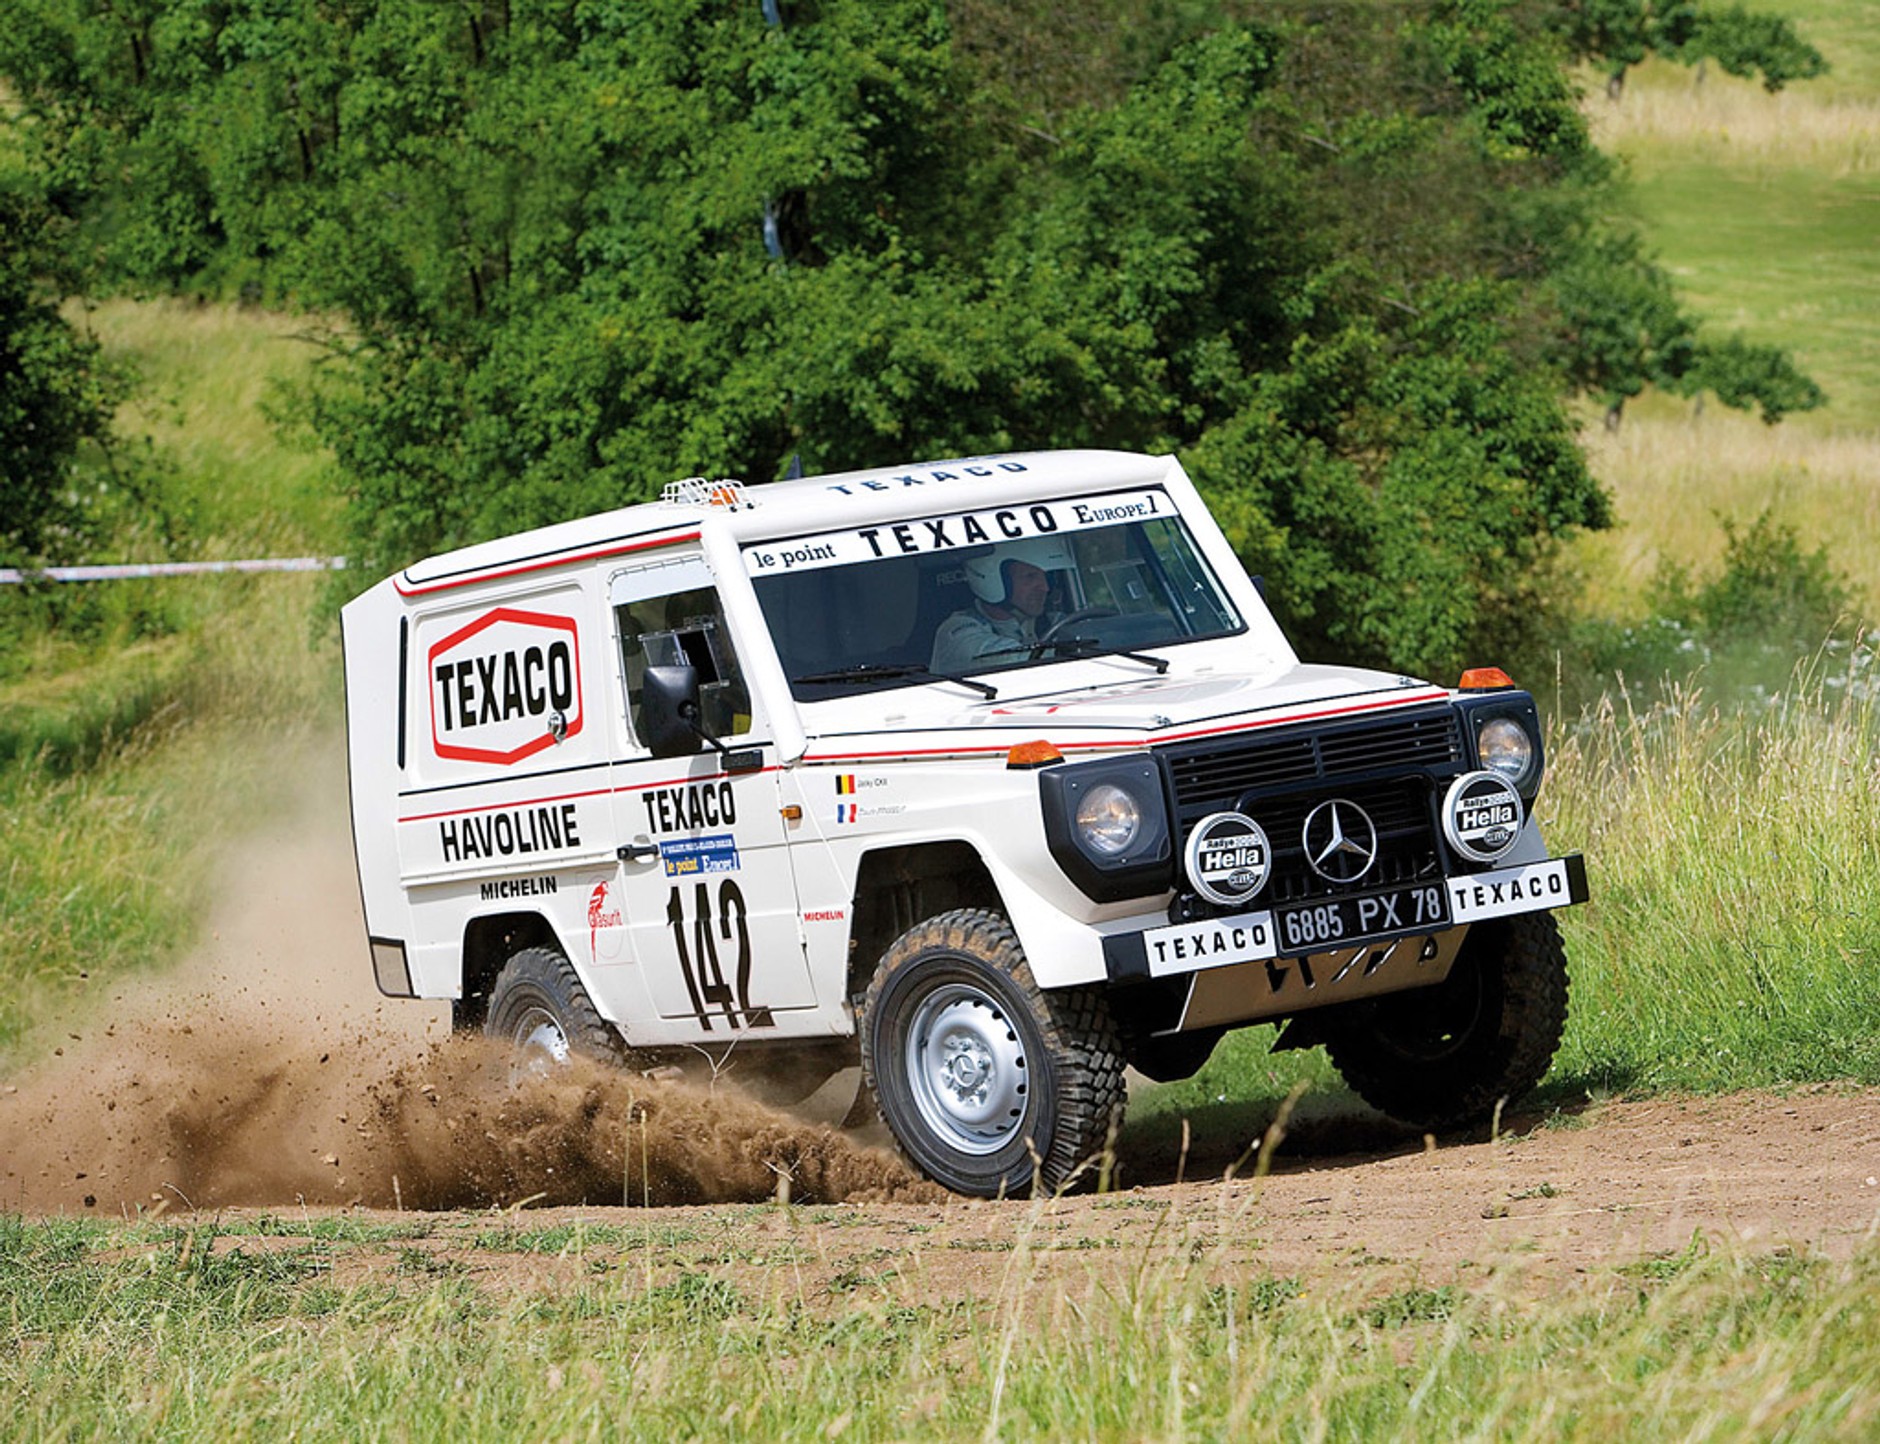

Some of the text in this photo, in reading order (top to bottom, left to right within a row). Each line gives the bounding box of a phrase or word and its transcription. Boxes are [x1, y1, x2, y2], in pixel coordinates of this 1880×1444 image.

[826, 462, 1028, 495] TEXACO
[752, 551, 776, 568] le
[780, 543, 836, 568] point
[858, 505, 1058, 557] TEXACO
[436, 641, 572, 731] TEXACO
[642, 781, 736, 834] TEXACO
[1463, 806, 1512, 829] Hella
[440, 804, 581, 862] HAVOLINE
[1205, 848, 1259, 870] Hella
[481, 876, 557, 900] MICHELIN
[1455, 873, 1562, 909] TEXACO
[804, 911, 844, 922] MICHELIN
[1285, 888, 1441, 944] 6885 PX 78
[666, 879, 776, 1031] 142
[1154, 924, 1266, 962] TEXACO
